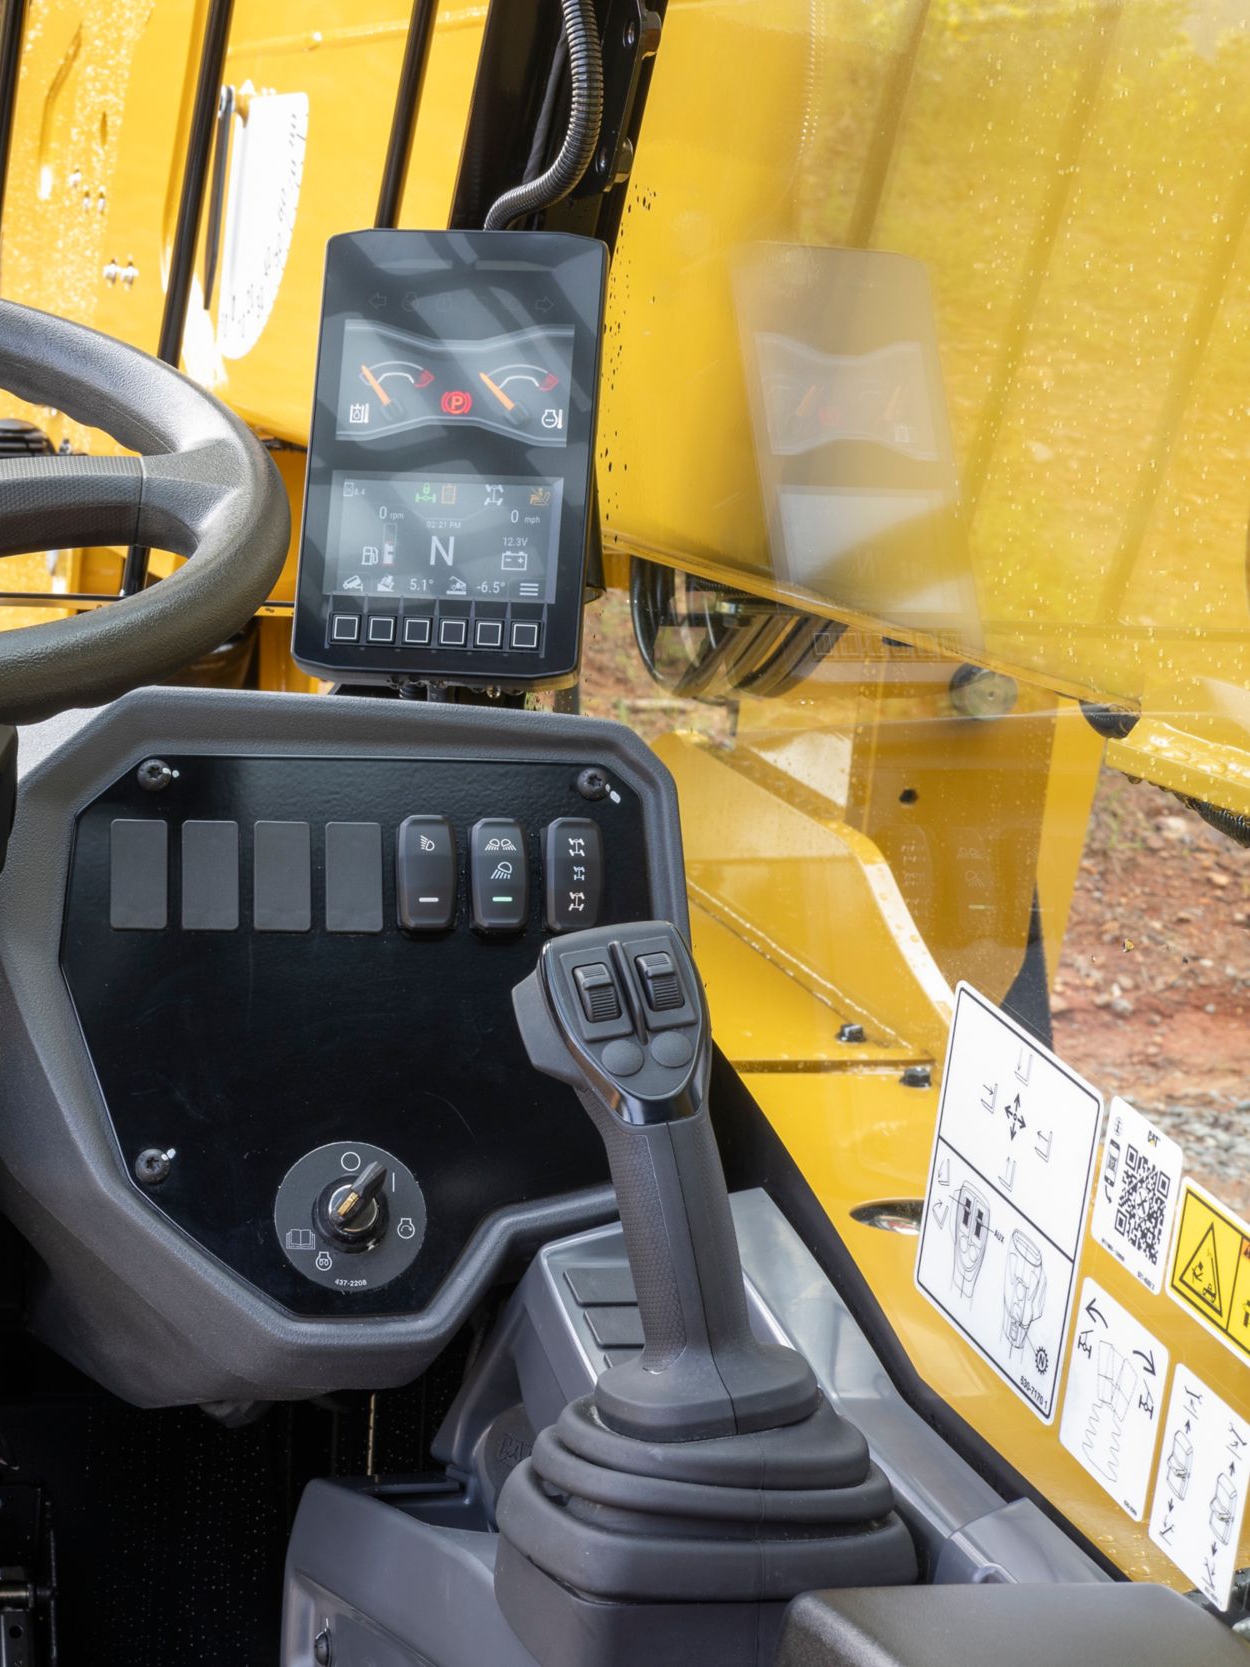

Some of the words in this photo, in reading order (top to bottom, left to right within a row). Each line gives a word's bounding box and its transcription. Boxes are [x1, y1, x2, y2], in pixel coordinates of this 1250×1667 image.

[379, 506, 388, 519] 0
[390, 512, 404, 520] rpm
[510, 509, 519, 523] 0
[524, 516, 541, 525] mph
[503, 536, 528, 547] 12.3V
[429, 535, 455, 567] N
[409, 578, 434, 591] 5.1°
[476, 580, 506, 594] -6.5°
[1148, 1130, 1159, 1148] CAT
[994, 1230, 1005, 1243] AUX
